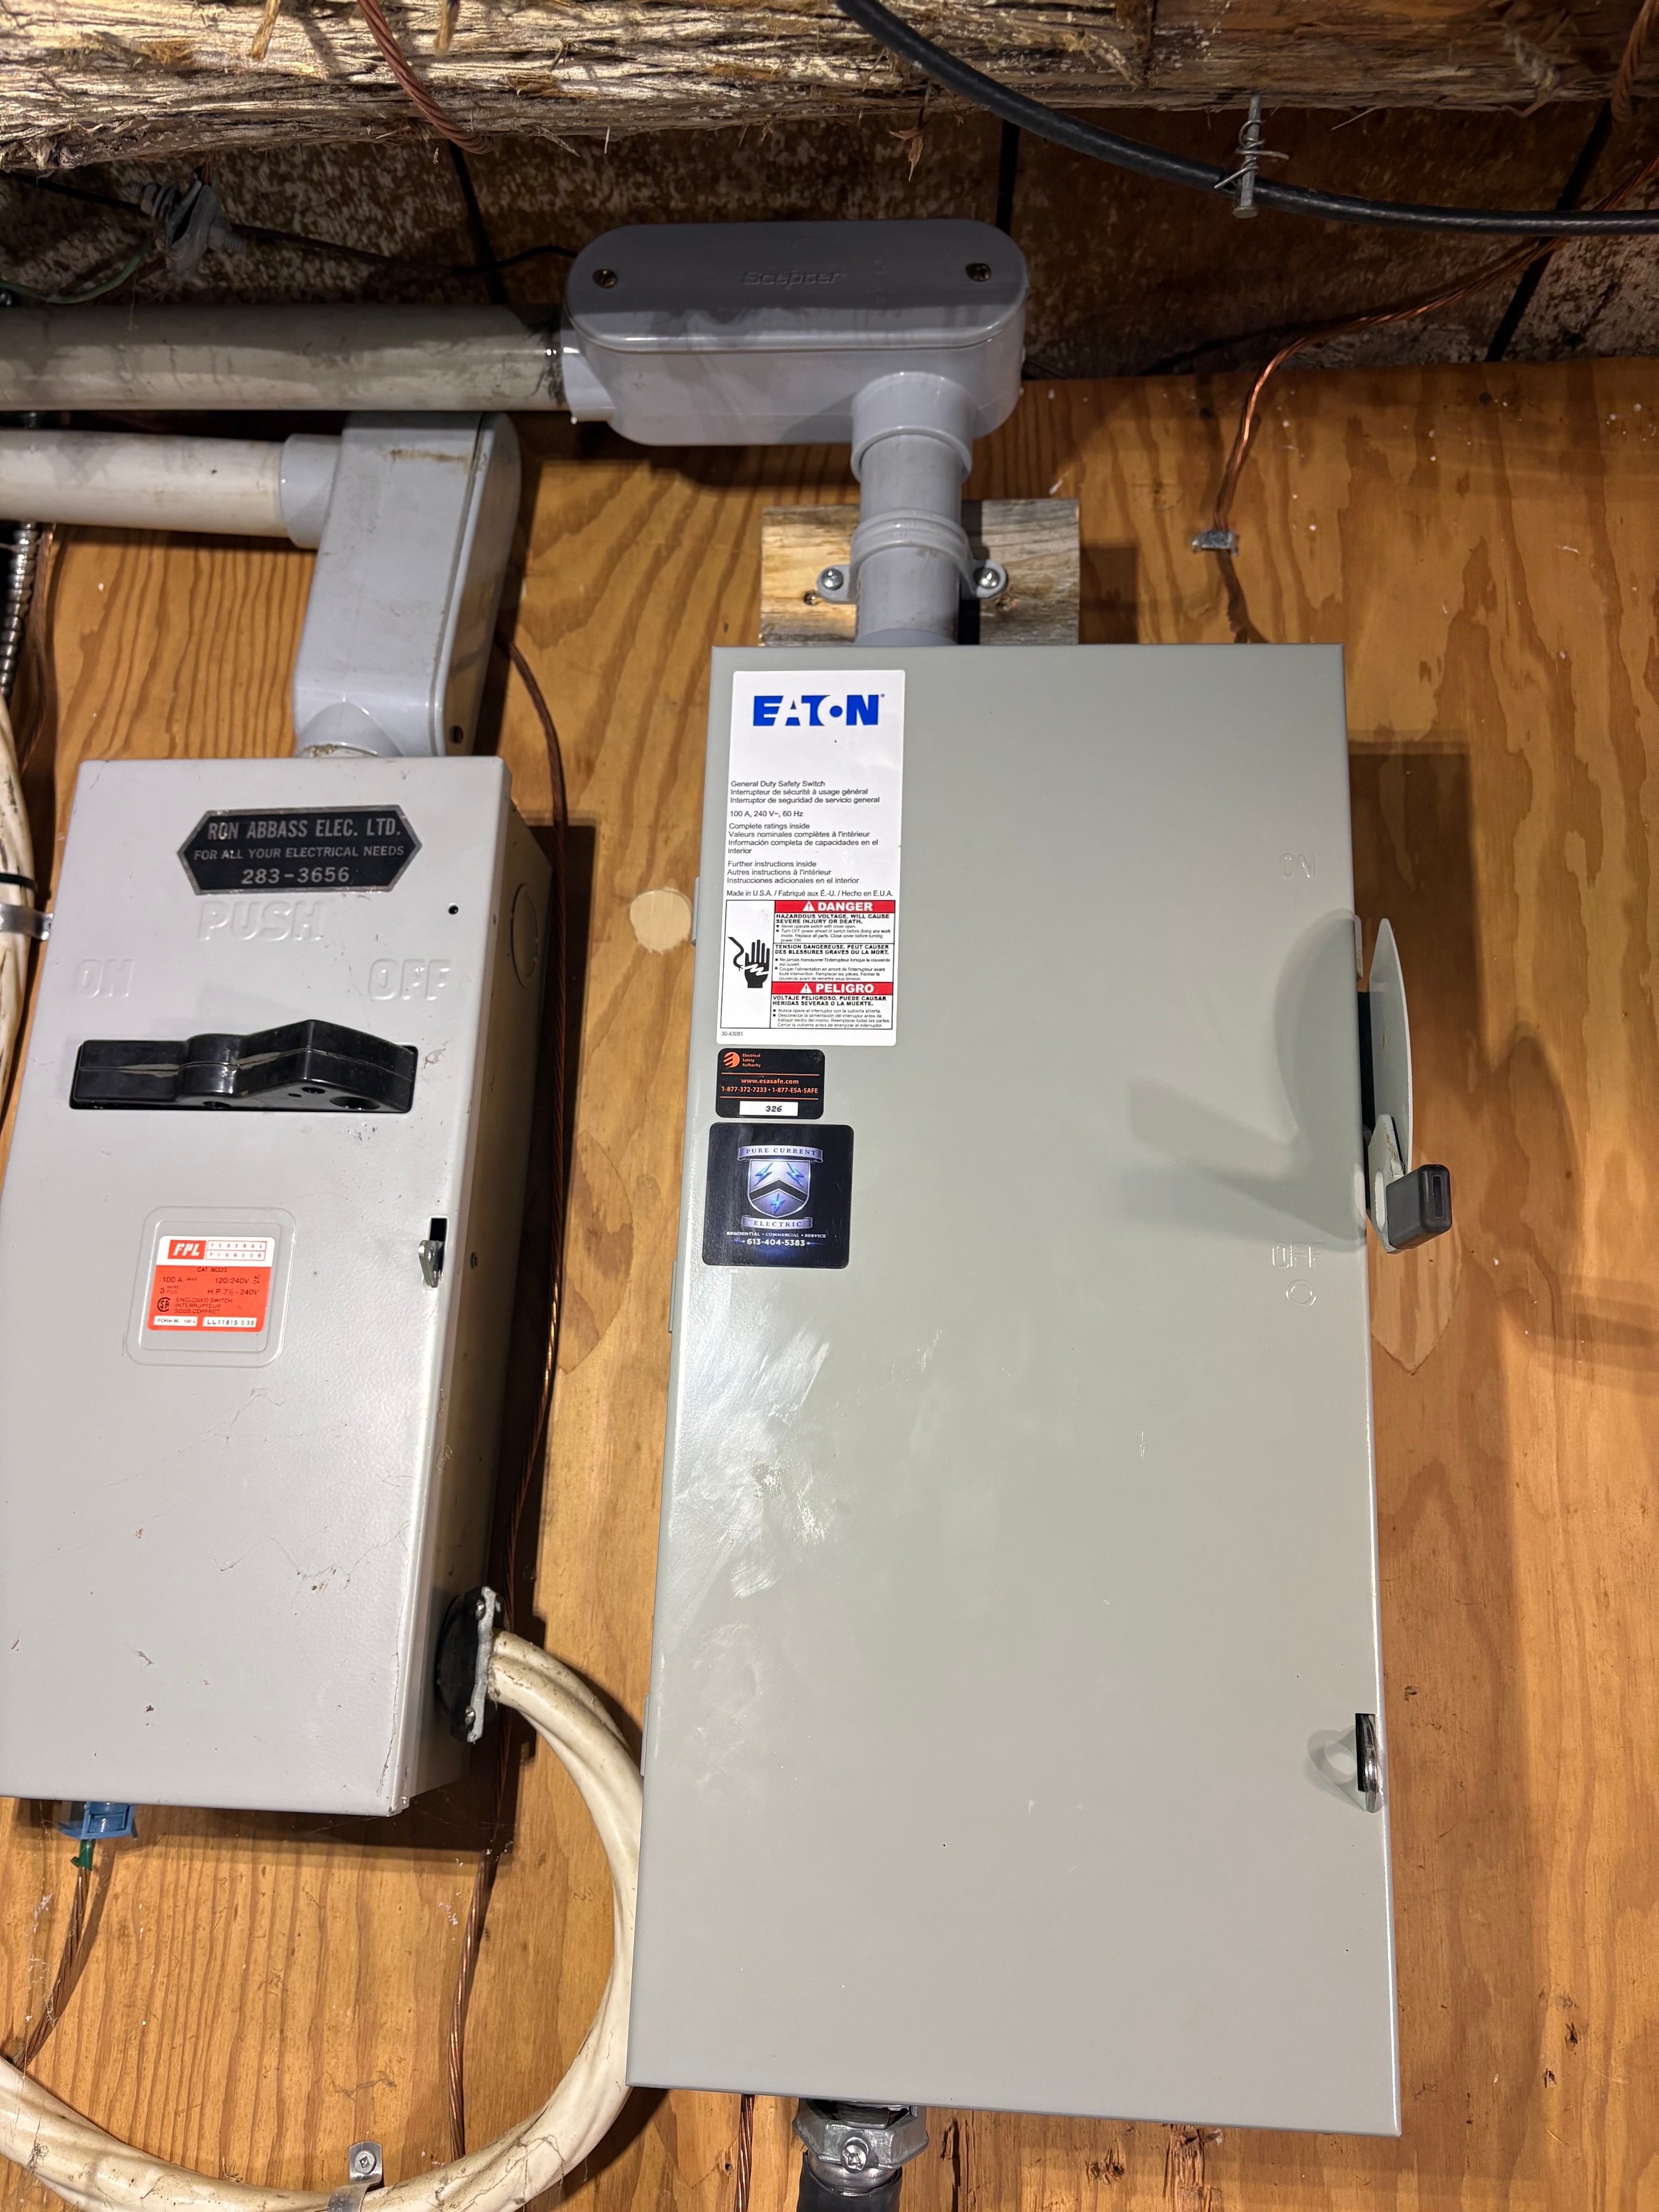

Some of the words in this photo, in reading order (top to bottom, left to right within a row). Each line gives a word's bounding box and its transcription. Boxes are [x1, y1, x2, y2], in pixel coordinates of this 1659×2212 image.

[753, 694, 879, 726] EATON
[778, 797, 813, 805] seguridad
[208, 822, 238, 840] RON
[247, 820, 308, 839] ABBASS
[315, 819, 358, 838] ELEC.
[366, 818, 401, 836] LTD.
[194, 850, 217, 861] FOR
[221, 849, 243, 859] ALL
[249, 848, 281, 859] YOUR
[286, 846, 358, 858] ELECTRICAL
[363, 845, 404, 857] NEEDS
[241, 866, 350, 885] 283-3656
[817, 902, 873, 912] DANGER
[198, 900, 324, 941] PUSH
[76, 958, 133, 998] ON
[369, 958, 452, 1000] OFF
[816, 984, 874, 994] PELIGRO
[773, 1147, 817, 1156] CURRENT
